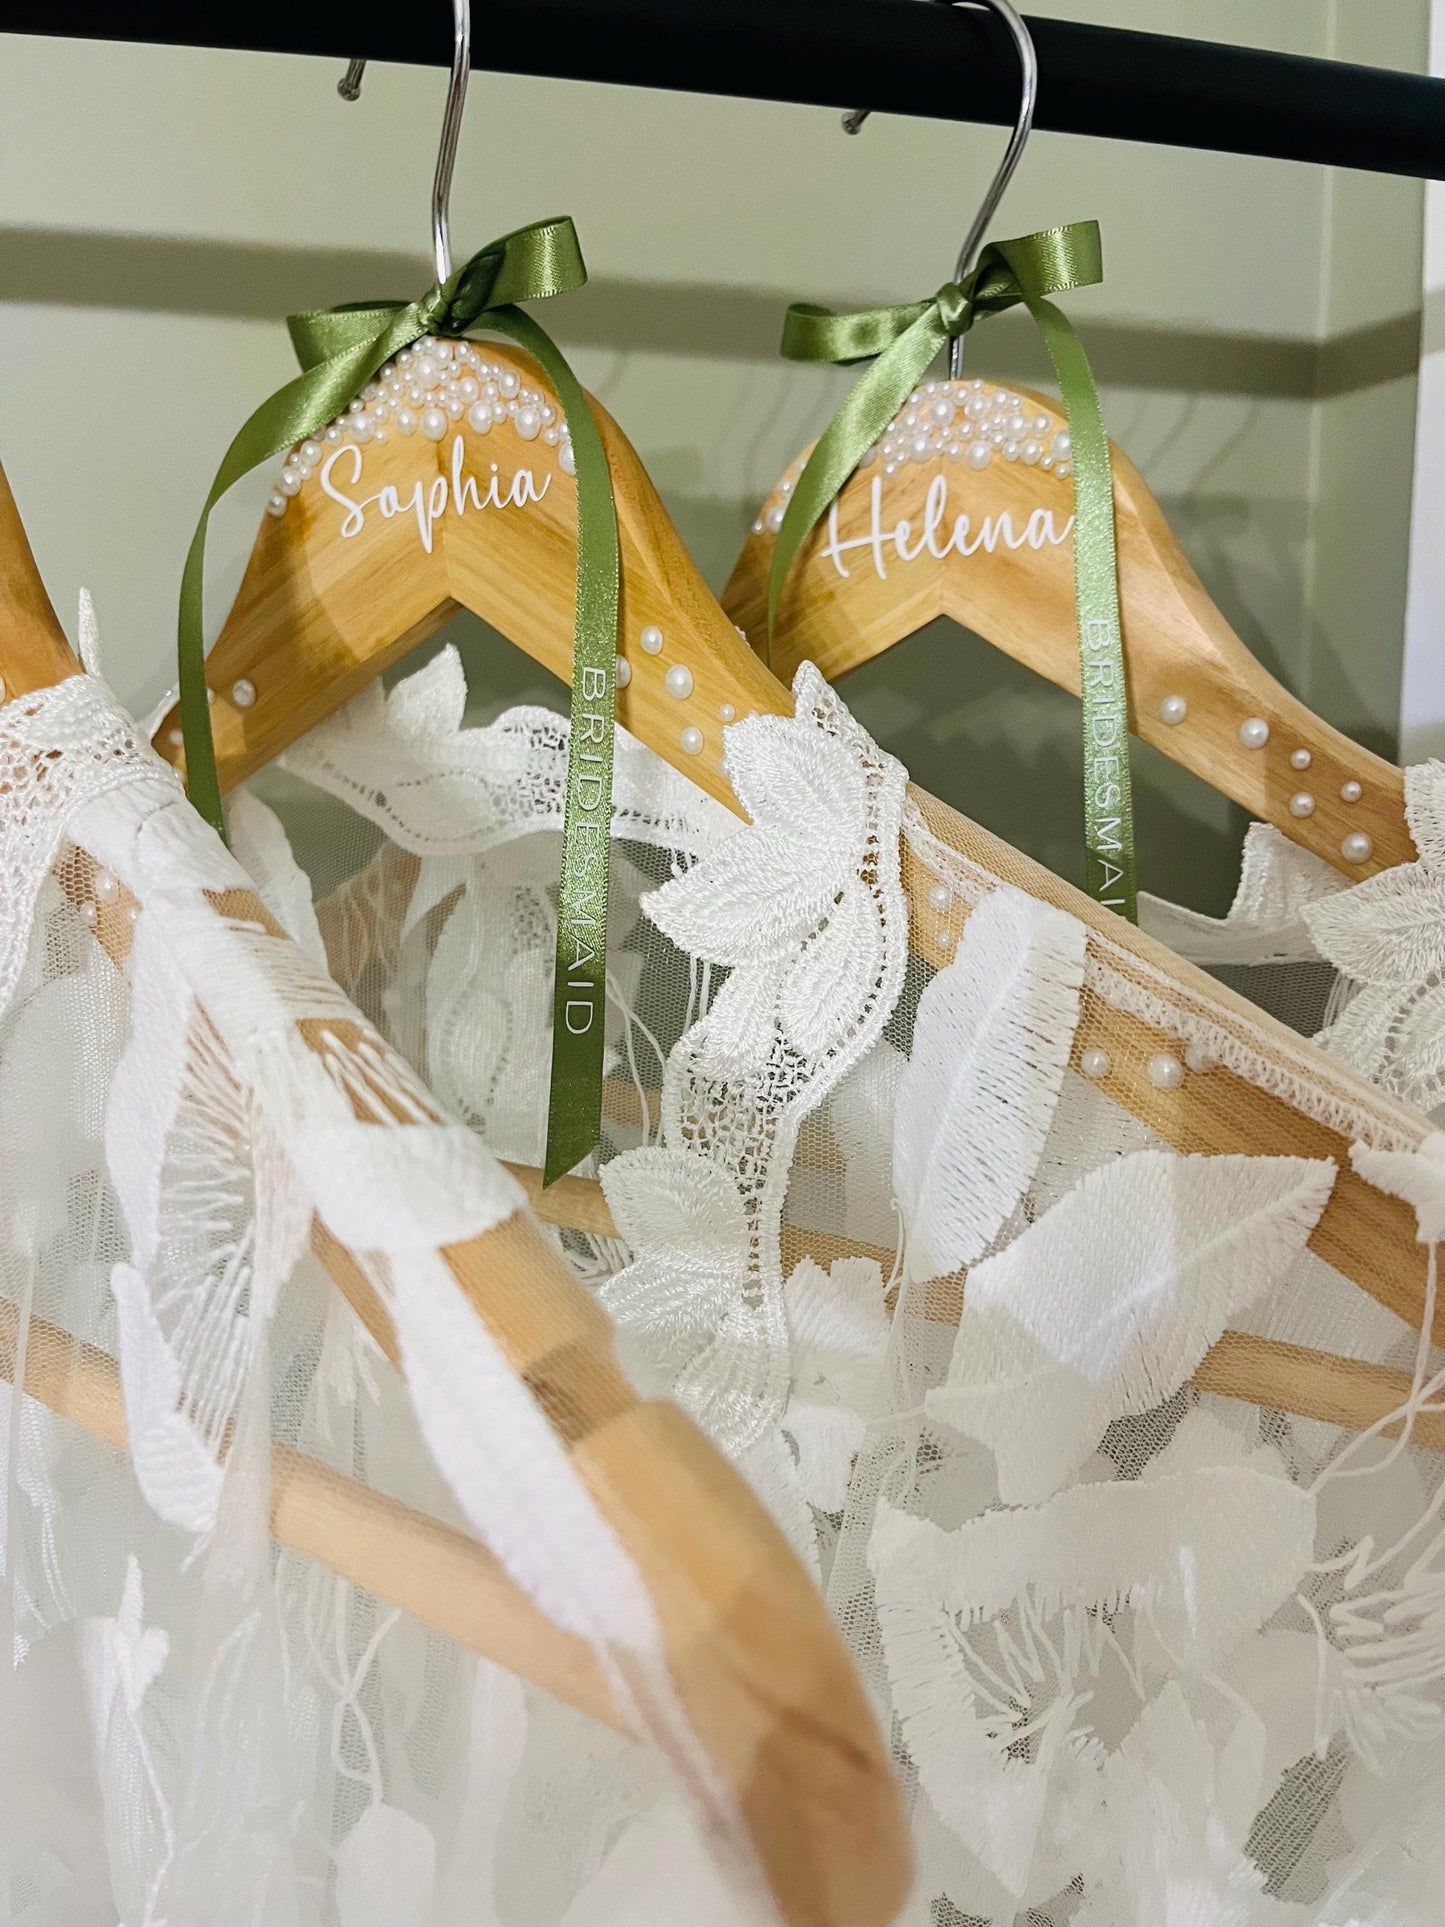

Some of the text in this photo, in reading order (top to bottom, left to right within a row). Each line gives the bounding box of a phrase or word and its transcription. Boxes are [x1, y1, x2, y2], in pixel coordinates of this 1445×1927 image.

[821, 474, 1075, 579] Helena
[565, 666, 606, 1035] BRIDESMAID
[1086, 618, 1126, 905] BRIDESMAI
